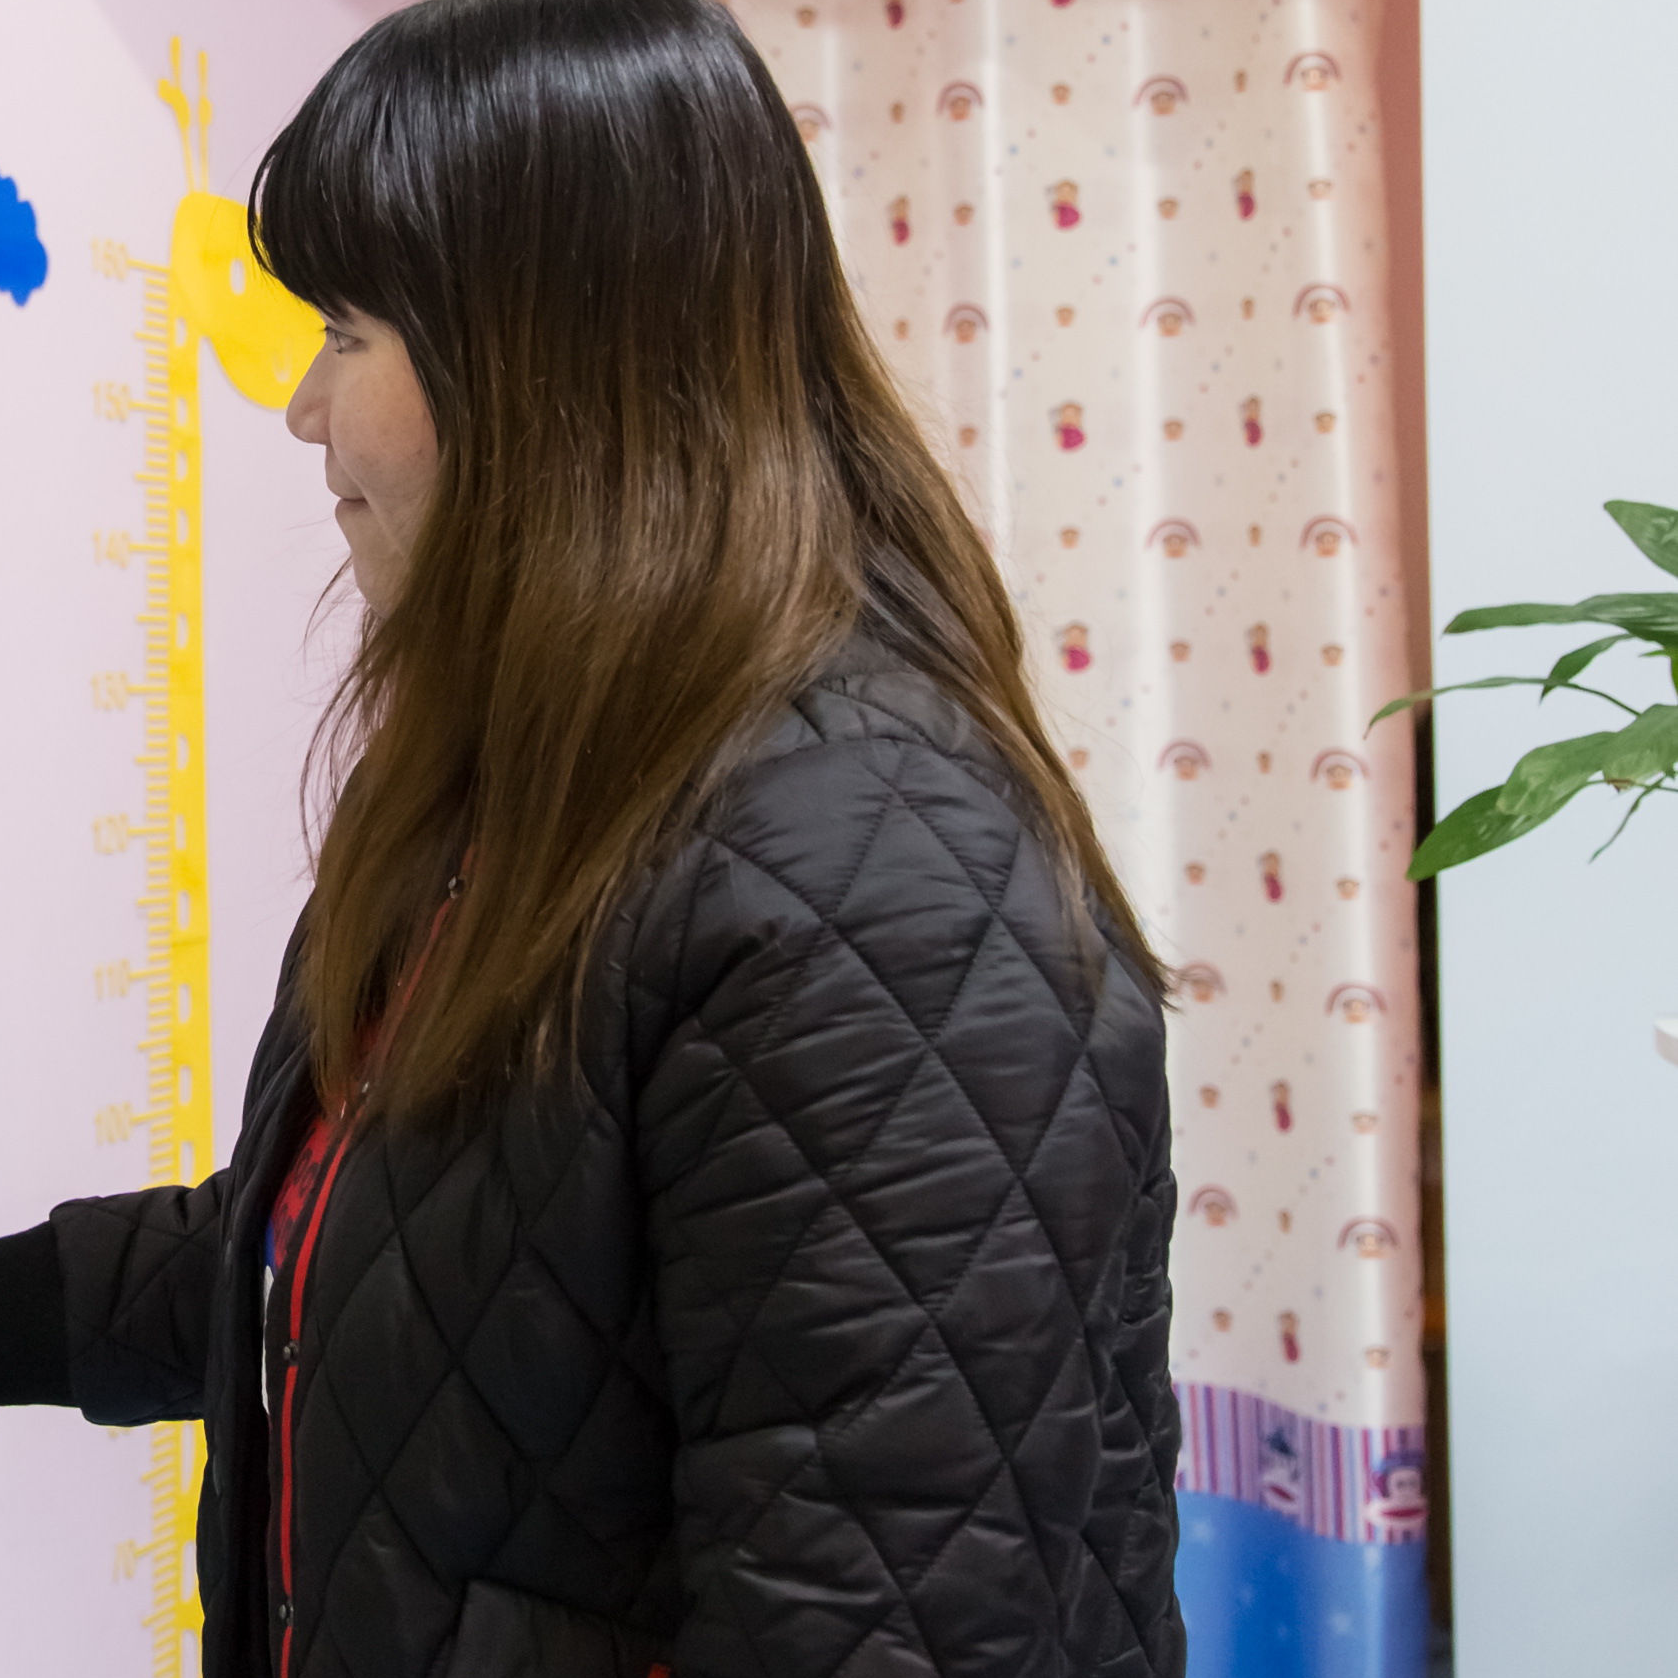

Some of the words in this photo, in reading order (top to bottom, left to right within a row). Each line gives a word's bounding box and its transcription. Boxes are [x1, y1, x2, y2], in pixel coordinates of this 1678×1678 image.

[90, 237, 129, 281] 160
[92, 382, 131, 423] 150
[92, 528, 131, 569] 140
[91, 672, 130, 712] 130
[92, 814, 130, 855] 120
[94, 959, 131, 1002] 110
[95, 1103, 132, 1147] 100
